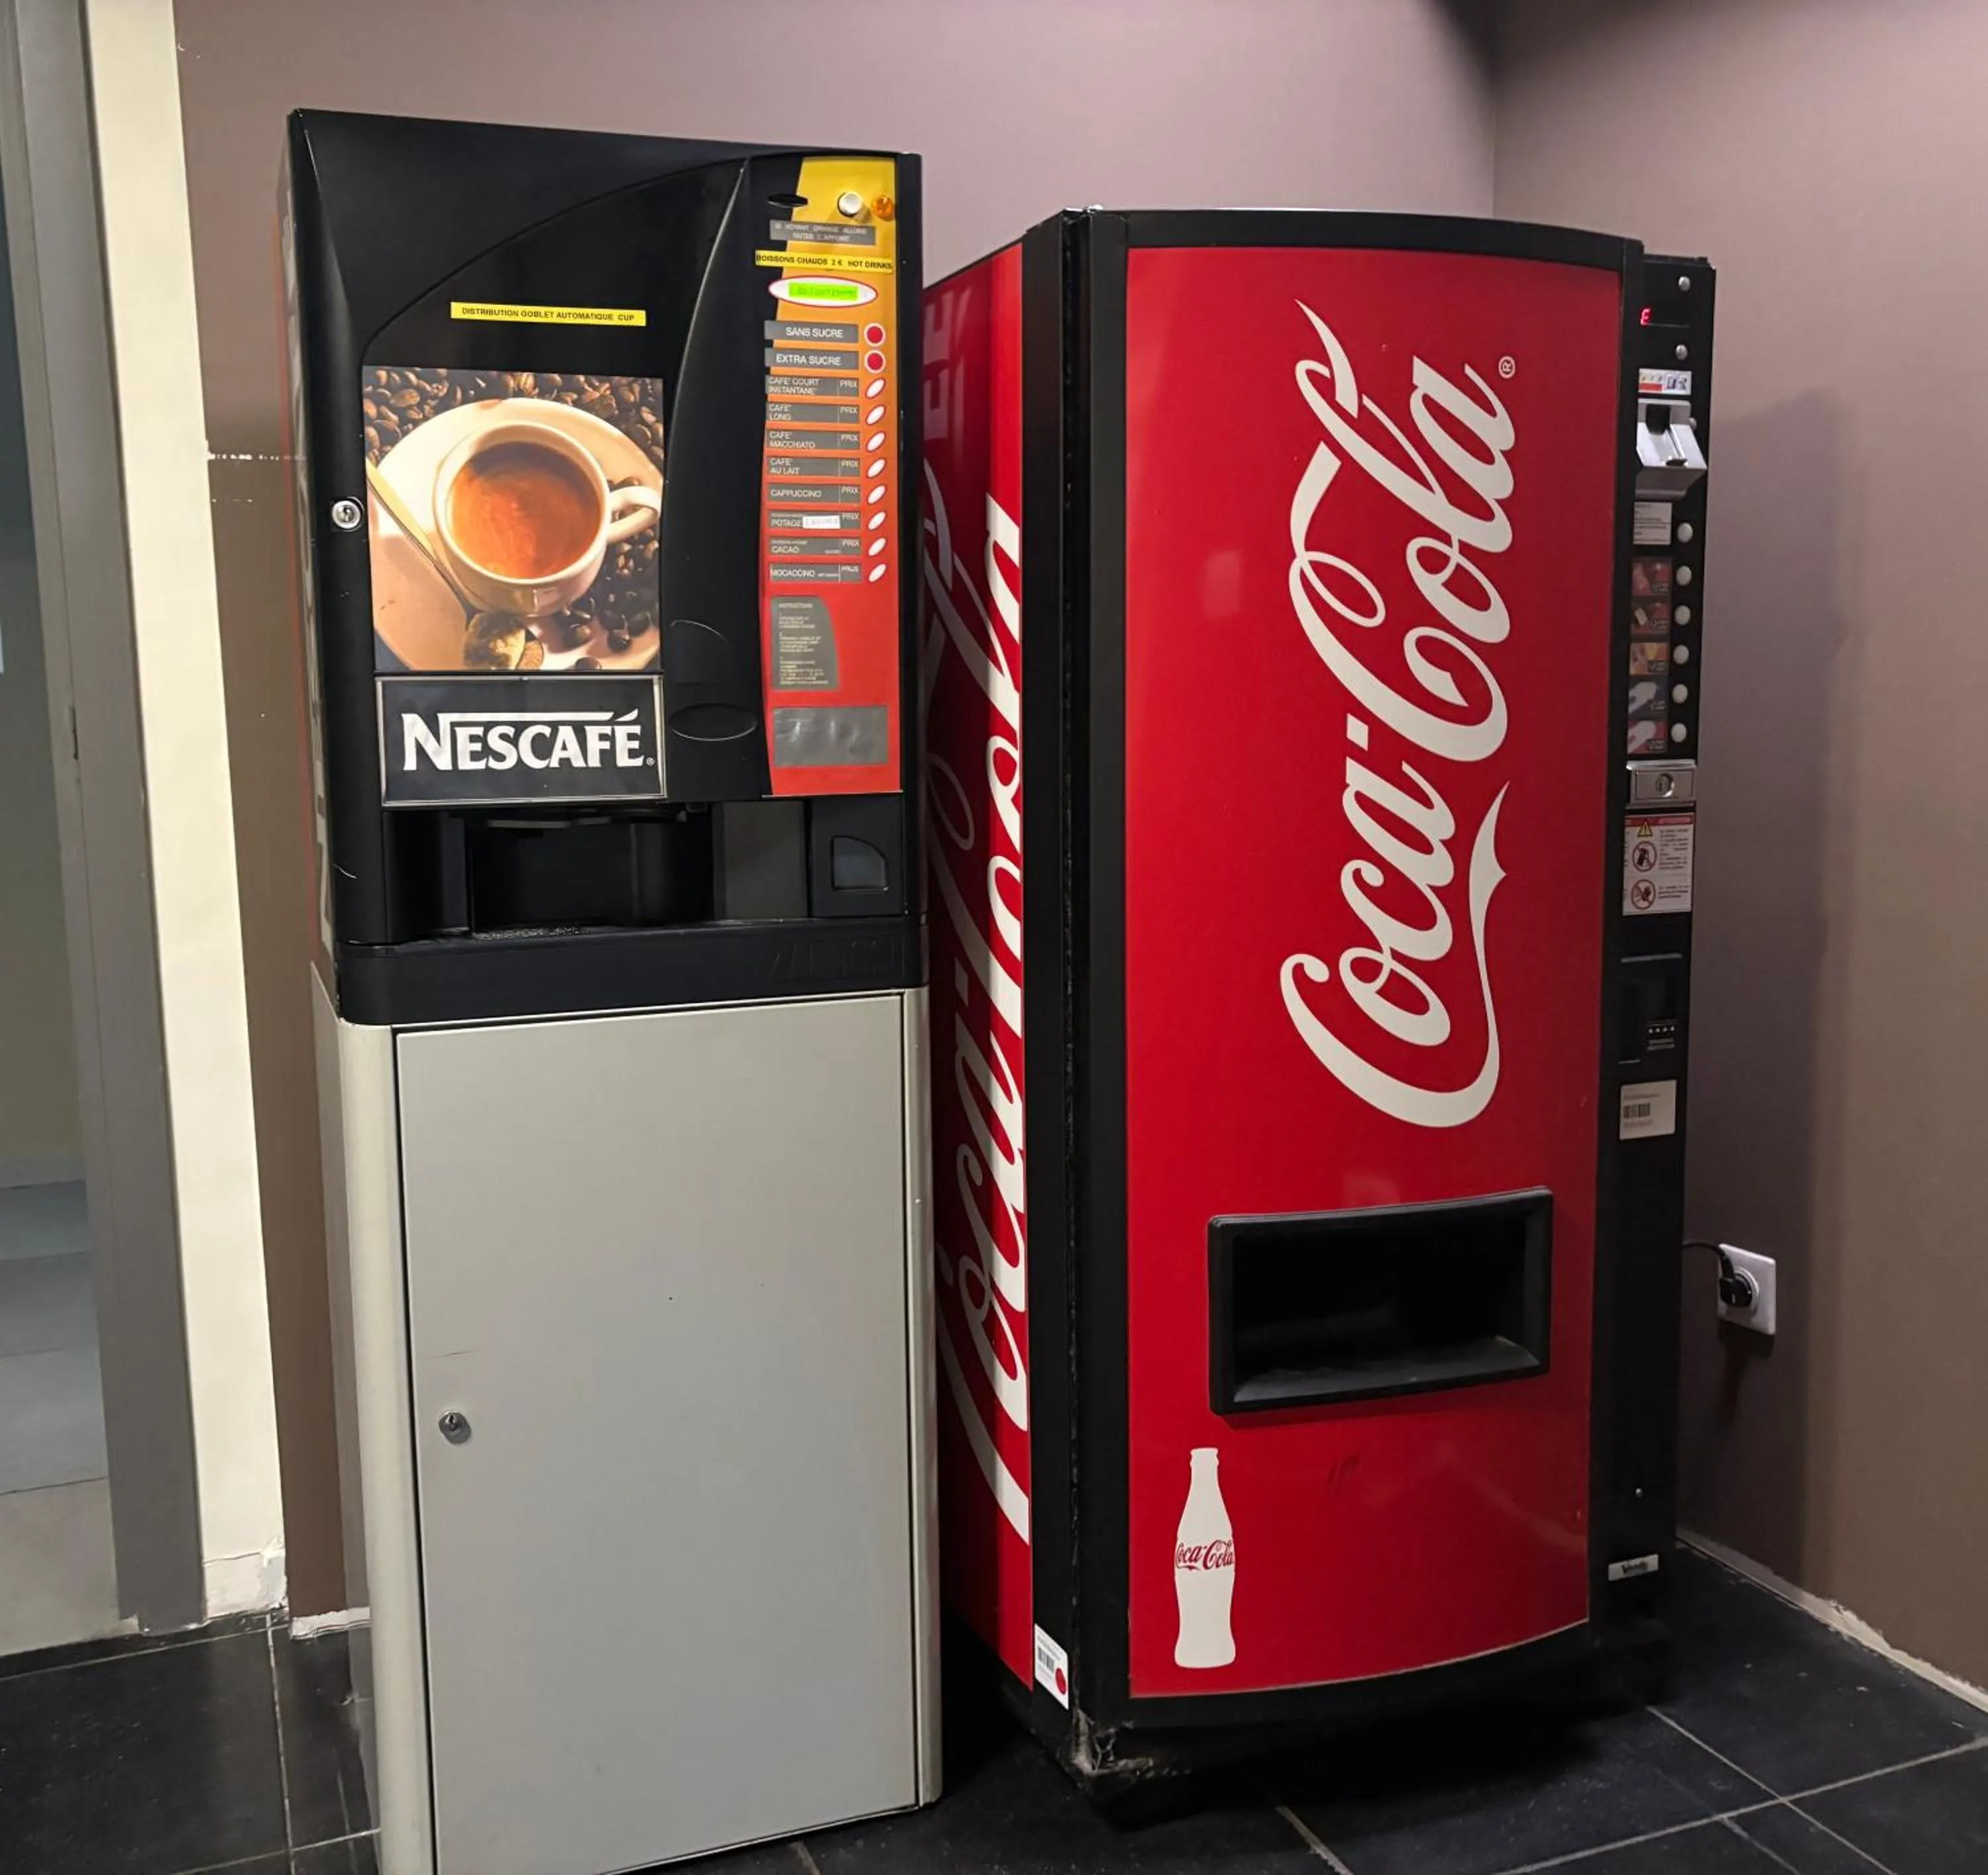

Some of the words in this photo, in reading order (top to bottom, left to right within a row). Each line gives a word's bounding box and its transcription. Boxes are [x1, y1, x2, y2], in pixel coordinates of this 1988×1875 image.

[756, 254, 795, 263] BOISSONS
[797, 257, 828, 266] CHAUDS
[462, 307, 519, 317] DISTRIBUTION
[521, 309, 554, 319] GOBLET
[556, 311, 614, 321] AUTOMATIQUE
[785, 327, 810, 337] SANS
[812, 328, 844, 338] SUCRE
[776, 353, 806, 364] EXTRA
[808, 355, 842, 366] SUCRE
[769, 441, 816, 449] MACCHIATO
[771, 489, 822, 498] CAPPUCCINO
[1280, 298, 1516, 1128] Coca-Cola
[401, 708, 645, 771] NESCAFÉ
[1176, 1539, 1234, 1571] Coca-Cola
